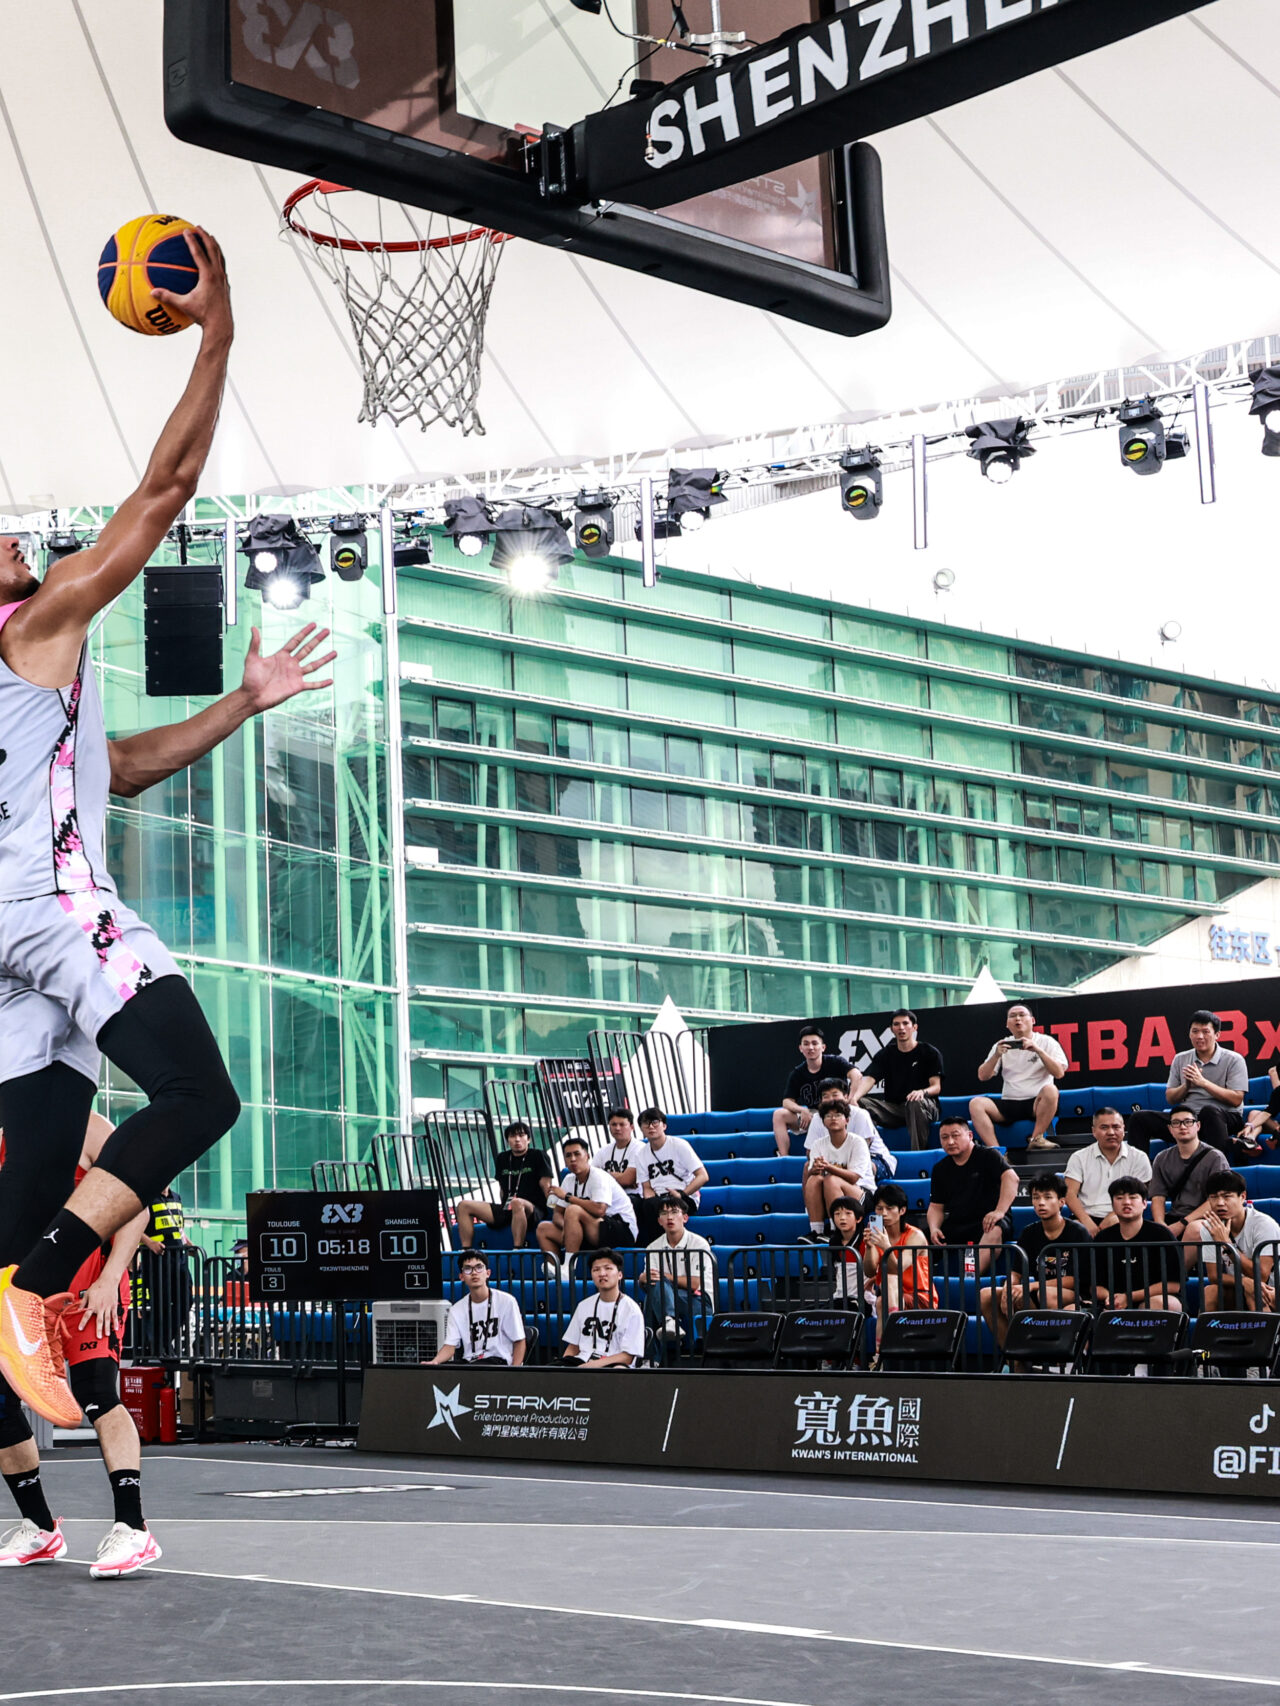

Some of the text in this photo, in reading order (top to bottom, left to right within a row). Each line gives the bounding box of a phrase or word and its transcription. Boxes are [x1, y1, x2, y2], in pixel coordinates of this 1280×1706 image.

[644, 0, 1061, 169] SHENZH
[1034, 1014, 1177, 1073] IBA
[320, 1203, 364, 1224] 3X3
[269, 1237, 297, 1257] 10
[317, 1239, 371, 1255] 05:18
[389, 1235, 418, 1255] 10
[268, 1277, 278, 1288] 3
[473, 1394, 591, 1412] STARMAC
[473, 1411, 589, 1425] Entertainment Production Ltd
[895, 1397, 921, 1448] 國際
[791, 1449, 918, 1464] KWAN'S INTERNATIONAL
[1213, 1445, 1280, 1479] @FI
